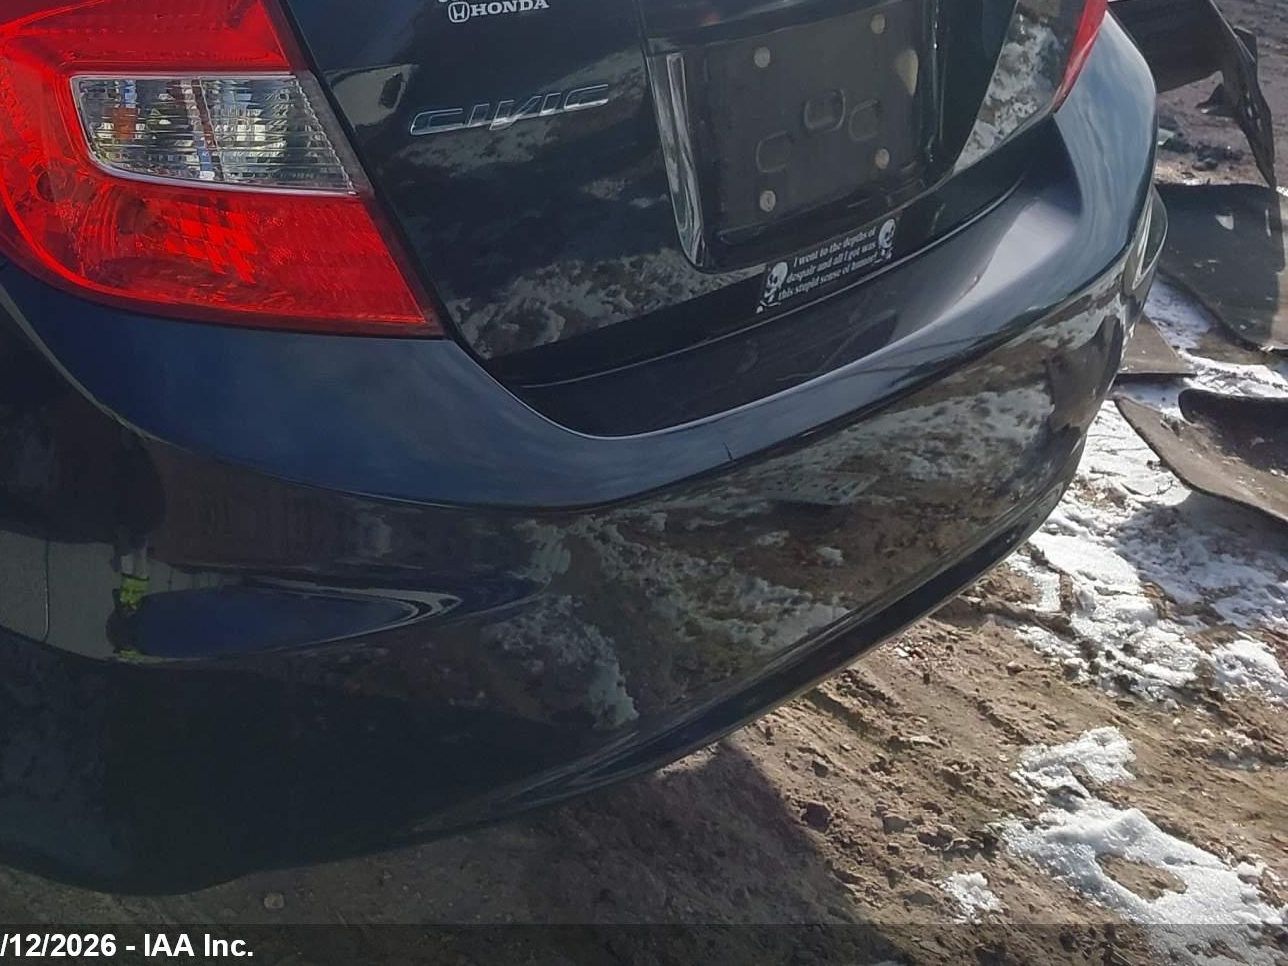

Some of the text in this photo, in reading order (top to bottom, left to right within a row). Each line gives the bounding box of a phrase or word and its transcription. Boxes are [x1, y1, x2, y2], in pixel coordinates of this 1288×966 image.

[410, 84, 609, 135] CIVIC
[817, 257, 833, 272] and
[833, 252, 844, 265] all
[848, 246, 861, 261] got
[861, 241, 876, 253] was
[820, 247, 829, 258] to
[829, 242, 842, 253] the
[868, 225, 877, 238] of
[778, 287, 793, 300] this
[795, 275, 820, 294] stupid
[820, 269, 842, 284] sense
